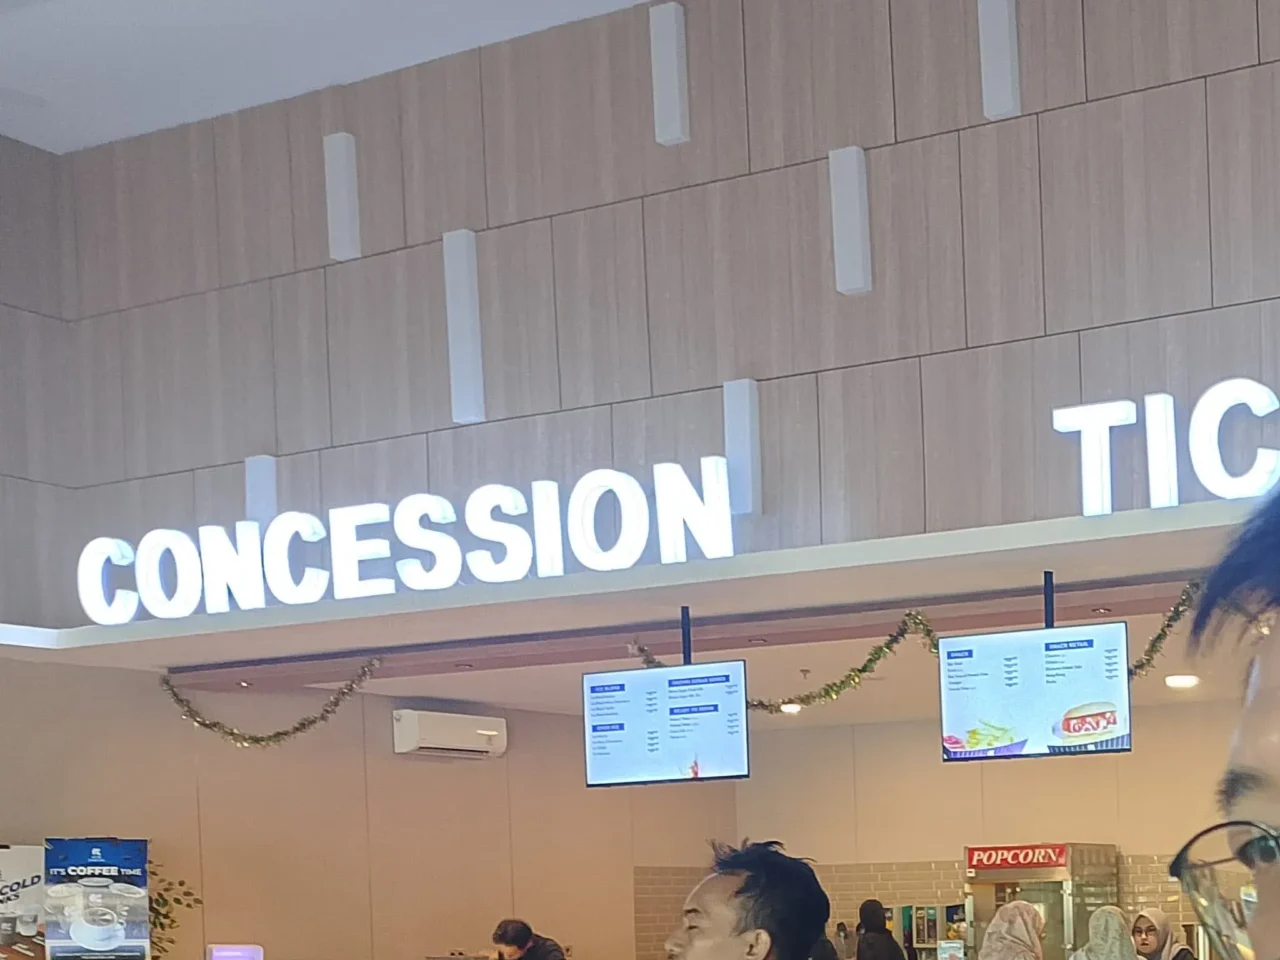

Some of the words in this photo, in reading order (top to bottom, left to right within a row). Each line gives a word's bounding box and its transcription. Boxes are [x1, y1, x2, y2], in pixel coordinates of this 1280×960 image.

[76, 454, 735, 626] CONCESSION
[971, 848, 1060, 866] POPCORN
[67, 866, 119, 876] COFFEE
[0, 874, 42, 896] COLD
